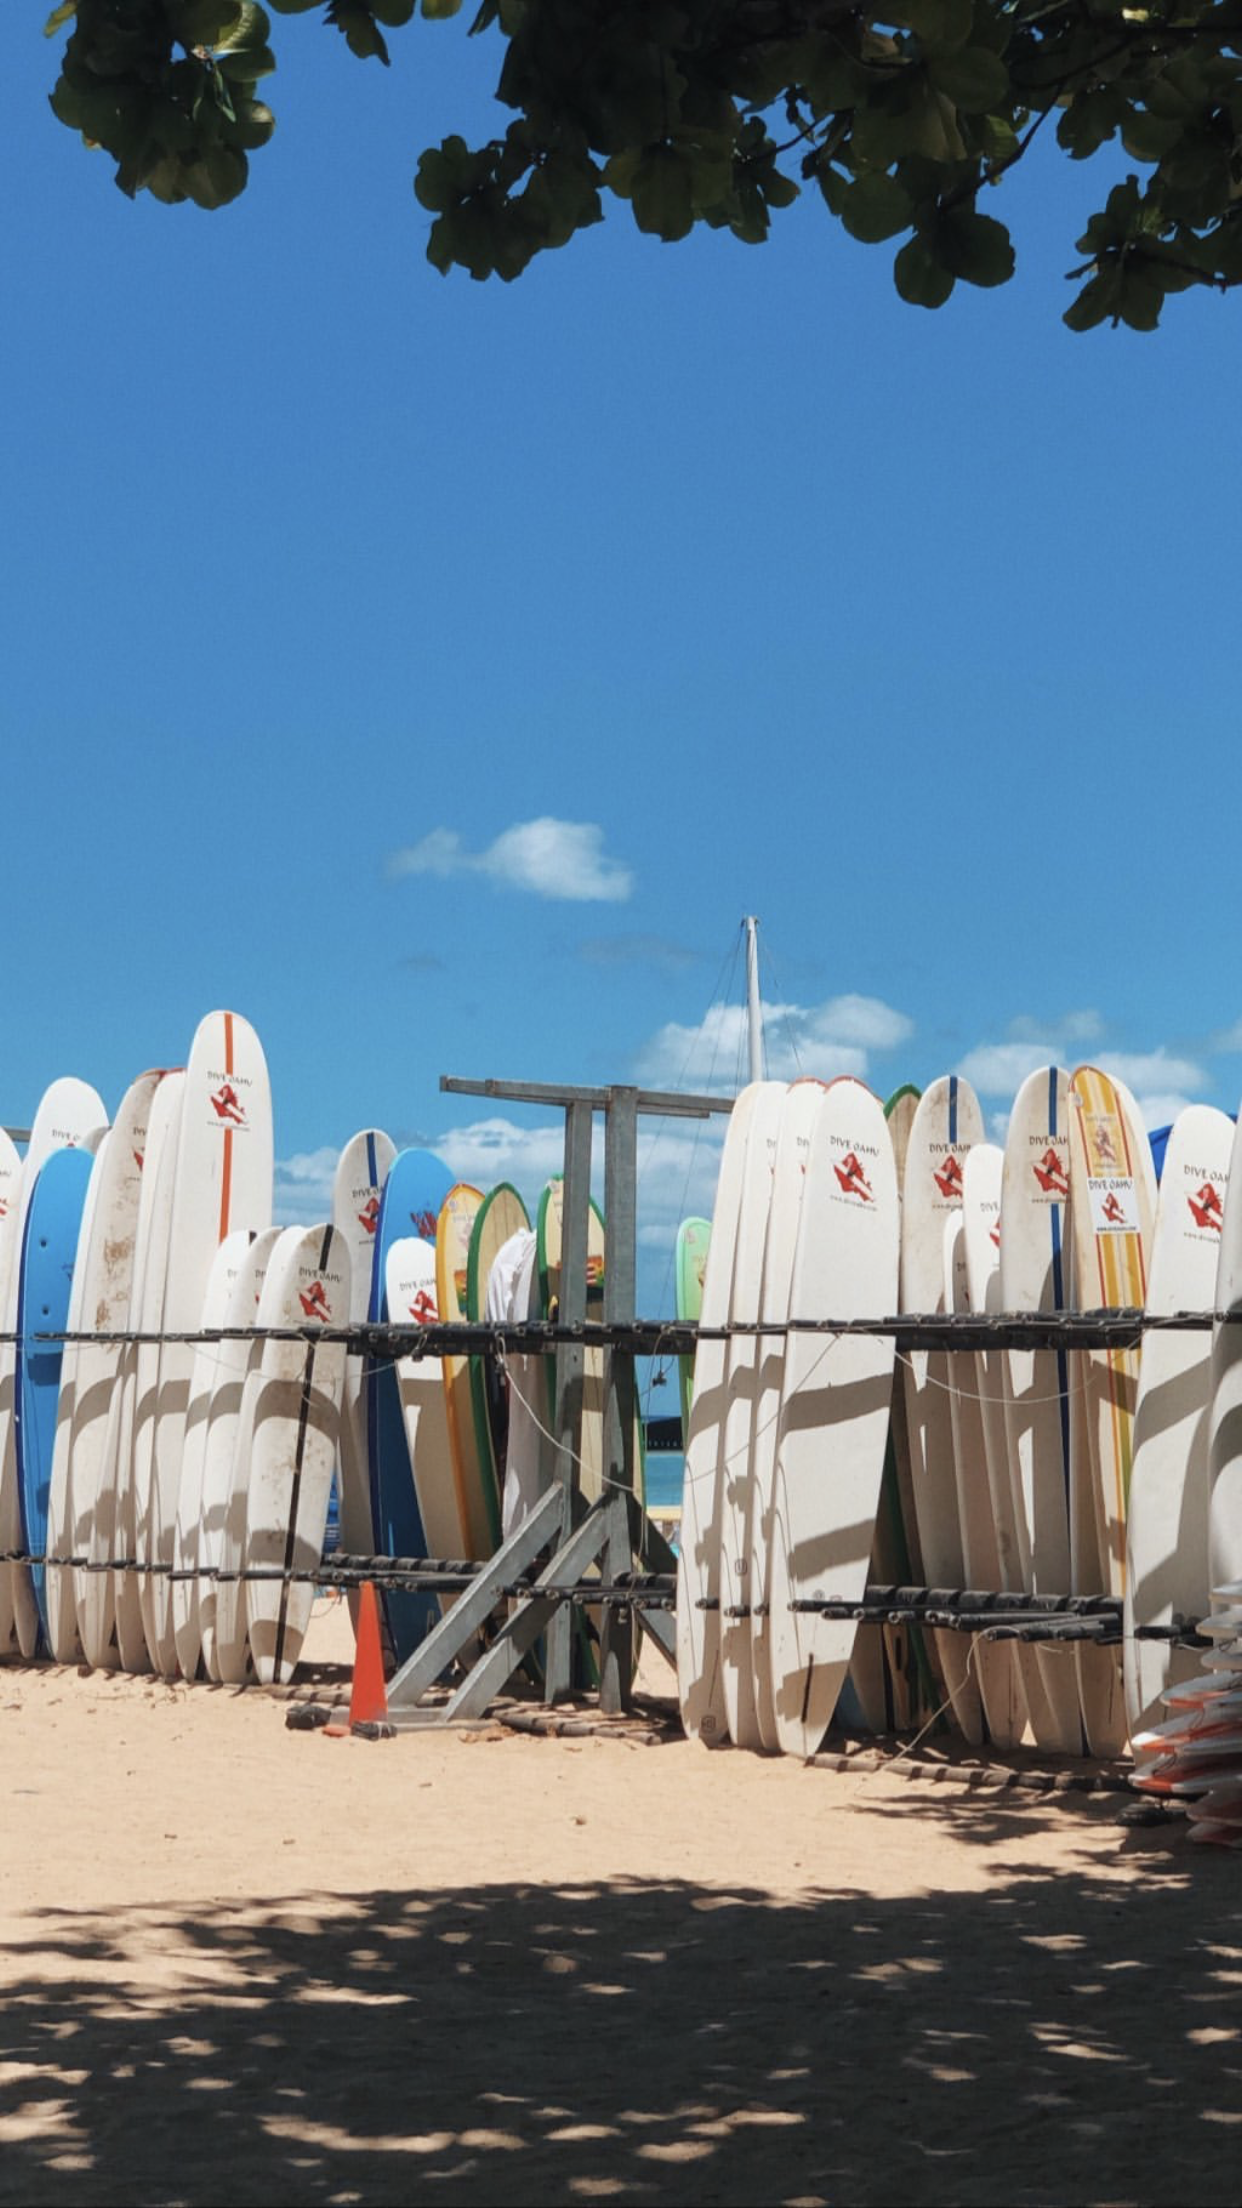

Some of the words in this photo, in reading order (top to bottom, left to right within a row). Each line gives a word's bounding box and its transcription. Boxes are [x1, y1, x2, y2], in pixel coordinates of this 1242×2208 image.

[829, 1134, 850, 1149] DIVE
[853, 1141, 880, 1158] OAHU
[1029, 1135, 1050, 1146] DIVE
[1052, 1135, 1068, 1146] OAH
[929, 1142, 949, 1154] DIVE
[951, 1142, 971, 1154] OAH
[1184, 1164, 1207, 1180] DIVE
[1209, 1170, 1231, 1184] OAH
[1088, 1179, 1108, 1191] DIVE
[1109, 1178, 1132, 1191] OAHU
[352, 1187, 370, 1198] DIVE
[980, 1202, 1001, 1214] DIVE
[299, 1267, 317, 1278] DIVE
[399, 1281, 418, 1292] DIVE
